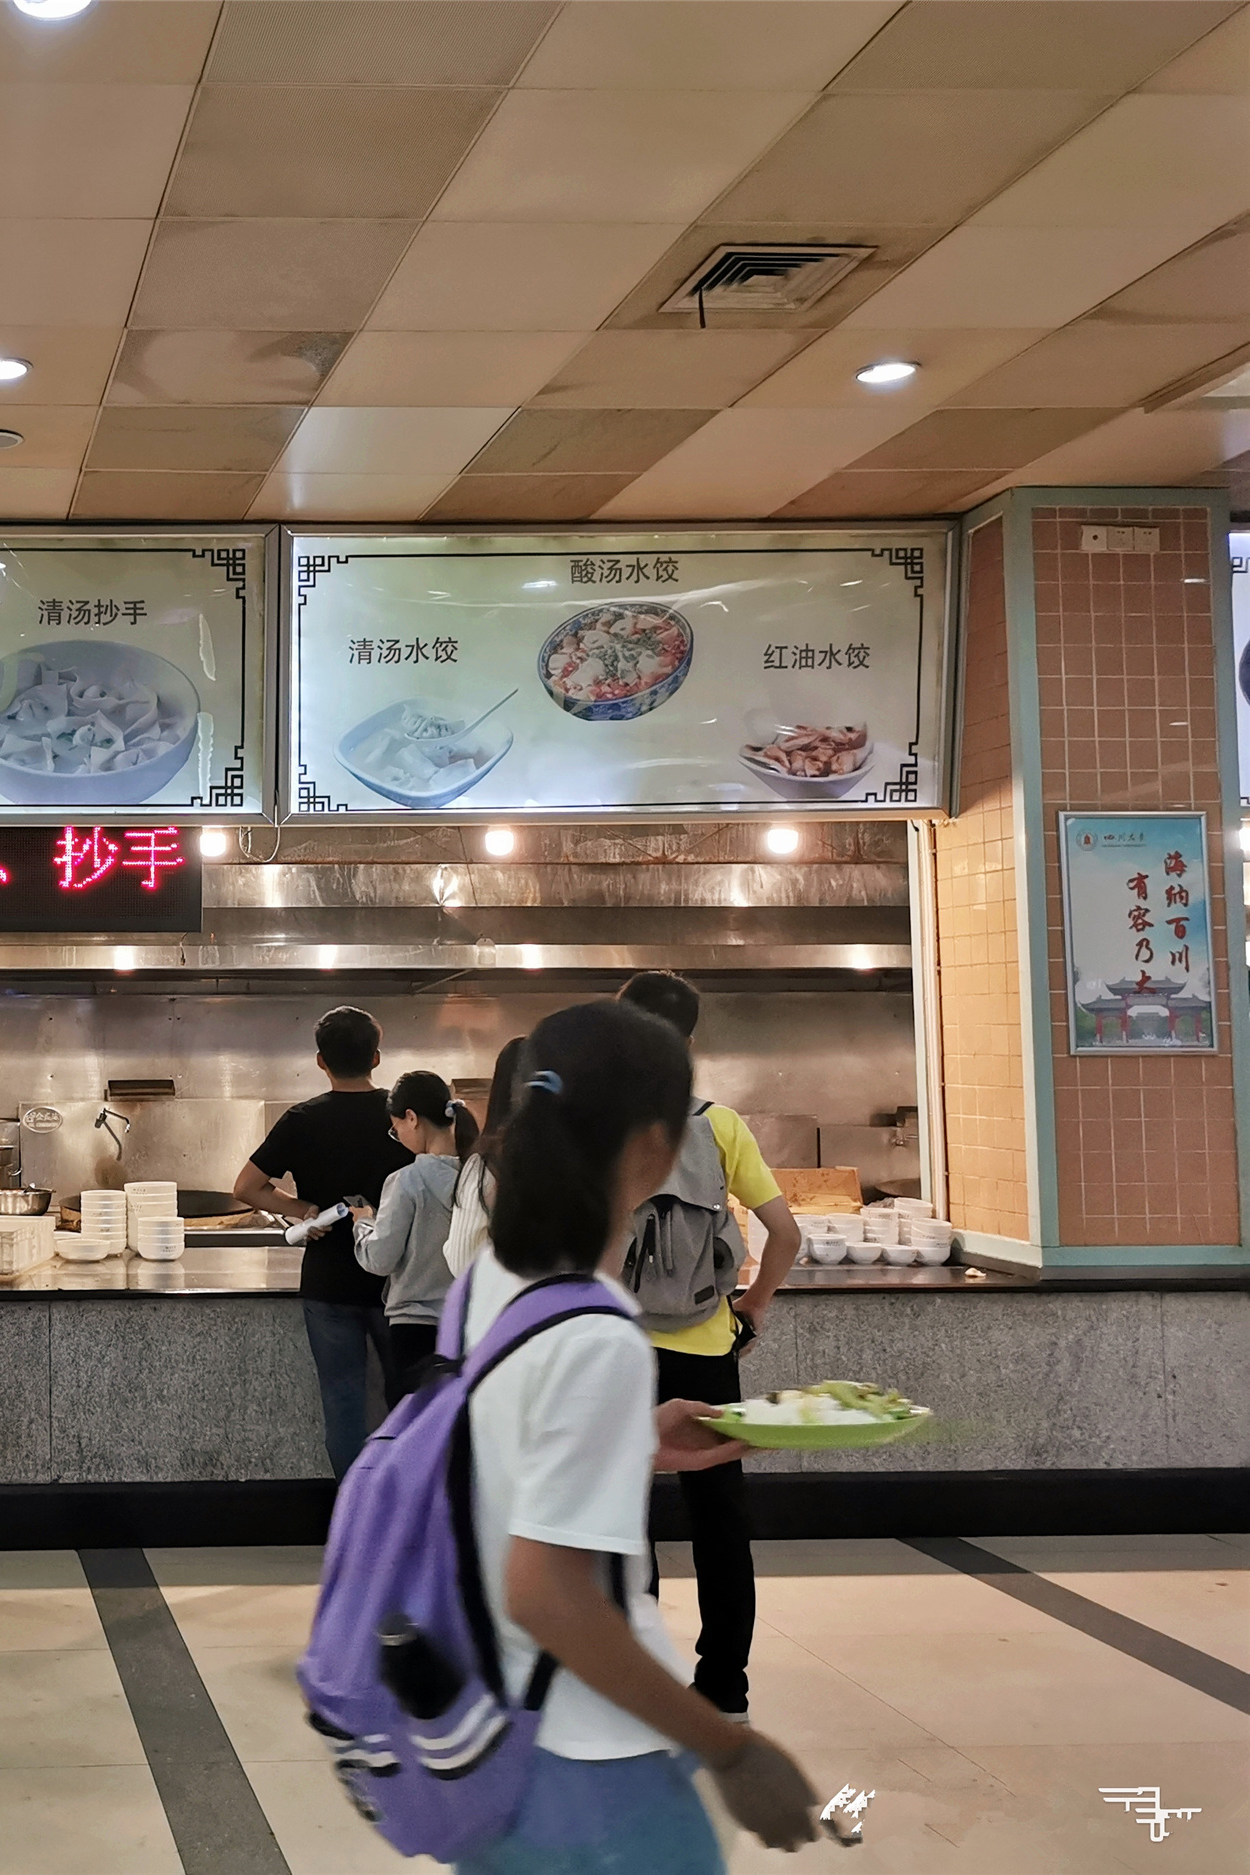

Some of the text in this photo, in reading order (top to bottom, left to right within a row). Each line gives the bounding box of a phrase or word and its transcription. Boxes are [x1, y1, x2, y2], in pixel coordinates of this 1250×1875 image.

[569, 556, 680, 585] 酸汤水饺
[37, 598, 148, 627] 清汤抄手
[348, 636, 459, 666] 清汤水饺
[763, 642, 871, 672] 红油水饺
[1164, 851, 1190, 973] 海纳百川
[1126, 872, 1157, 995] 有容乃大
